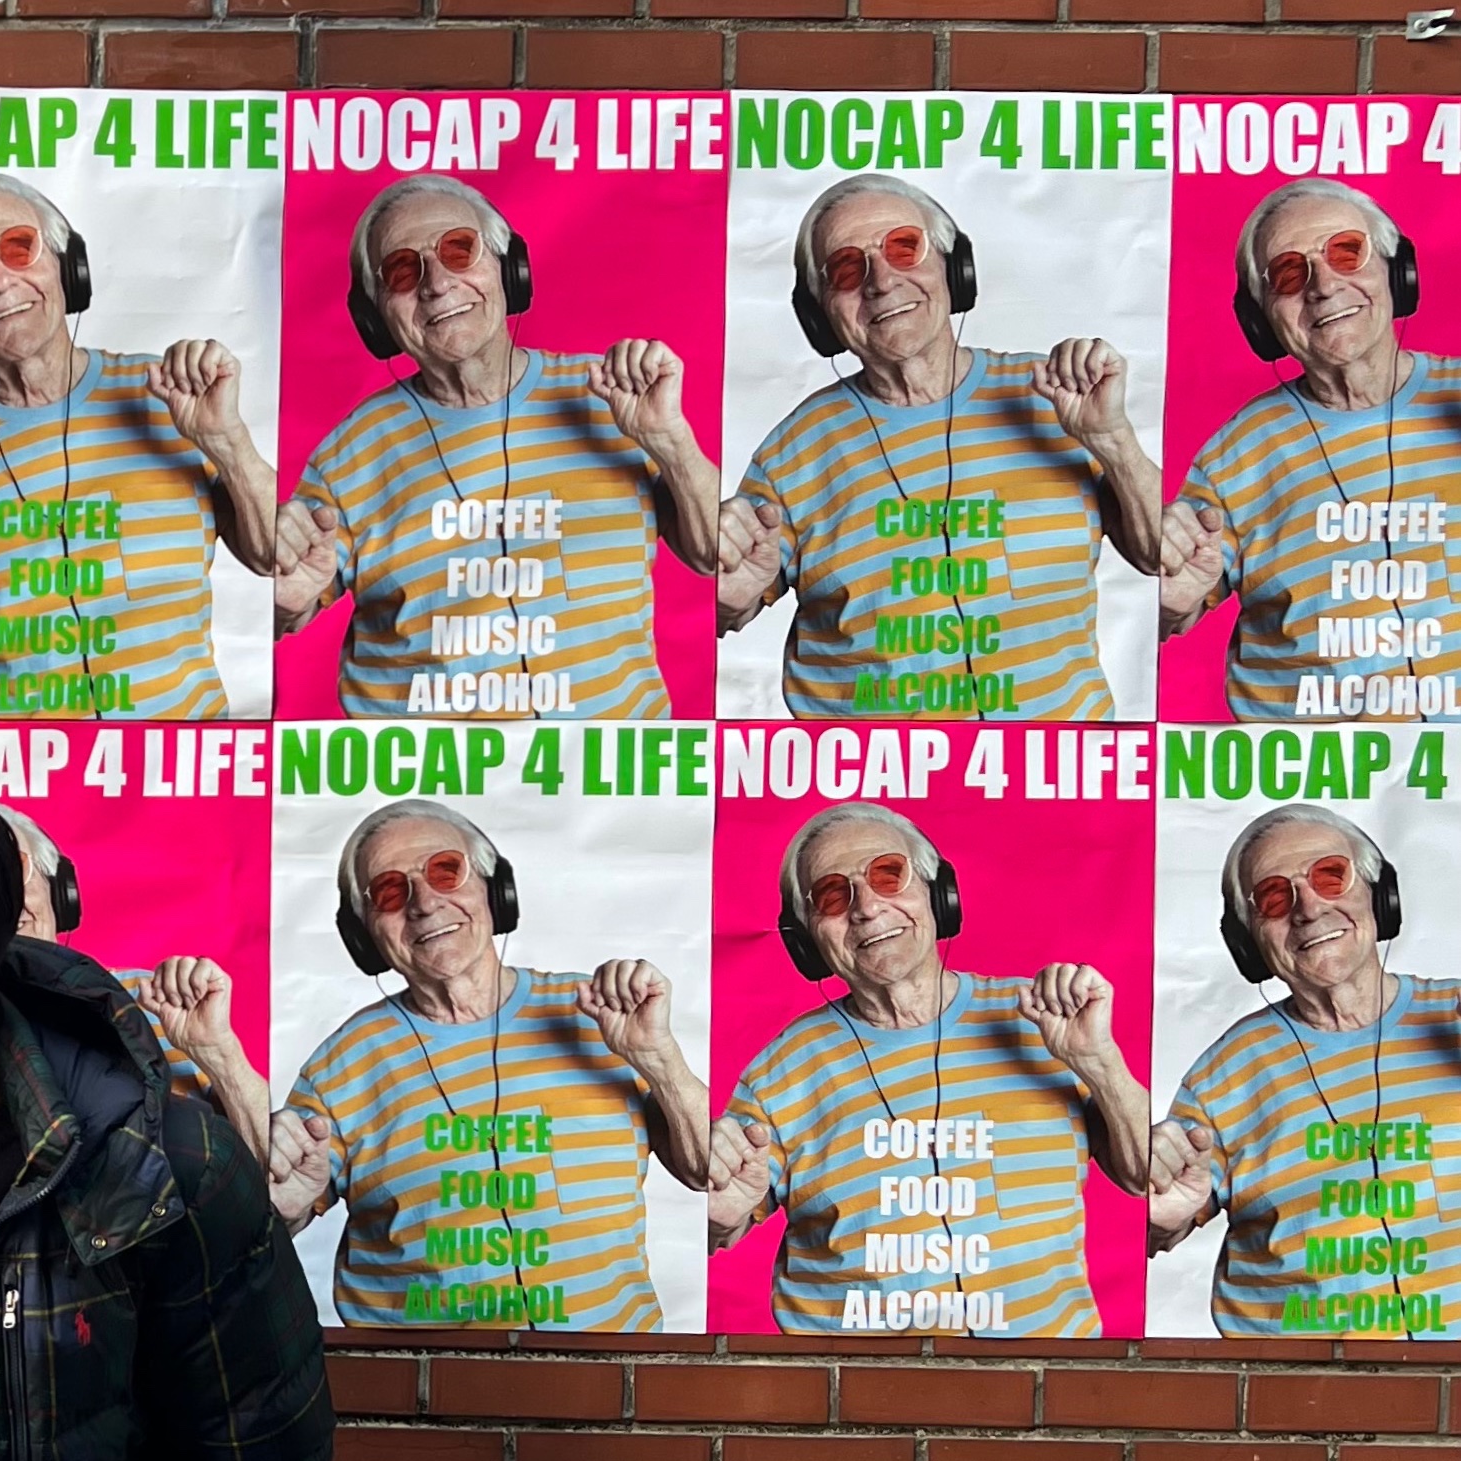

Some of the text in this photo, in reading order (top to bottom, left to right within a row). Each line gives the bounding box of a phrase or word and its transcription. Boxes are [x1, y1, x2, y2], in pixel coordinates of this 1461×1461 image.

[94, 98, 136, 168] 4
[155, 100, 278, 169] LIFE
[293, 97, 723, 171] NOCAP 4 LIFE
[737, 99, 1166, 170] NOCAP 4 LIFE
[1179, 102, 1461, 175] NOCAP 4
[431, 500, 563, 540] COFFEE
[875, 498, 1005, 539] COFFEE
[1315, 500, 1446, 542] COFFEE
[9, 557, 105, 598] FOOD
[447, 558, 544, 598] FOOD
[890, 556, 988, 597] FOOD
[1330, 558, 1427, 600] FOOD
[431, 616, 556, 656] MUSIC
[875, 614, 1000, 656] MUSIC
[1317, 616, 1441, 658] MUSIC
[407, 673, 576, 713] ALCOHOL
[852, 672, 1020, 713] ALCOHOL
[1295, 673, 1461, 716] ALCOHOL
[84, 729, 126, 797] 4
[143, 729, 265, 797] LIFE
[281, 727, 708, 796] NOCAP 4 LIFE
[722, 727, 1150, 800] NOCAP 4 LIFE
[1165, 729, 1447, 800] NOCAP 4
[423, 1113, 553, 1154] COFFEE
[863, 1118, 993, 1160] COFFEE
[1305, 1121, 1432, 1162] COFFEE
[439, 1170, 537, 1210] FOOD
[879, 1176, 975, 1217] FOOD
[1319, 1178, 1416, 1218] FOOD
[425, 1227, 550, 1267] MUSIC
[864, 1232, 989, 1275] MUSIC
[1305, 1236, 1427, 1276] MUSIC
[404, 1285, 570, 1325] ALCOHOL
[841, 1290, 1007, 1332] ALCOHOL
[1281, 1292, 1447, 1333] ALCOHOL
